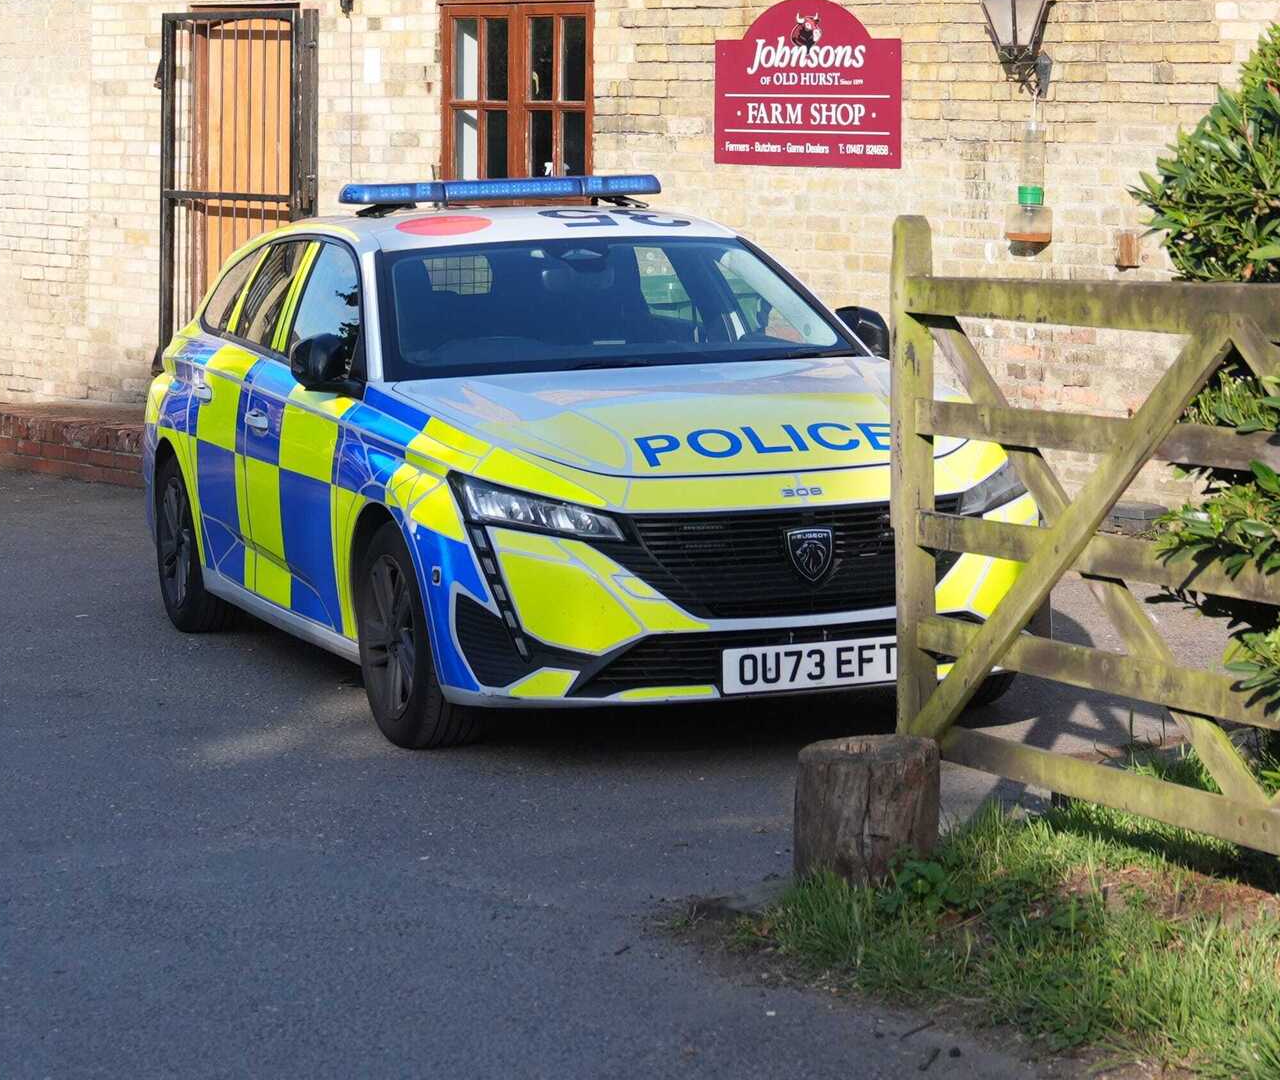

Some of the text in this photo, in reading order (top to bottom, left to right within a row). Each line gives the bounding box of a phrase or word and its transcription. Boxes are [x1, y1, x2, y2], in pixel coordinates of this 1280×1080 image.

[746, 36, 866, 75] Johnsons
[760, 76, 771, 85] OF
[773, 72, 798, 86] OLD
[800, 72, 840, 86] HURST
[746, 102, 866, 126] FARM SHOP
[725, 141, 750, 152] Farmers
[754, 141, 782, 153] Butchers
[786, 142, 805, 153] Game
[805, 142, 830, 154] Dealers
[634, 422, 891, 468] POLICE
[782, 487, 823, 497] 308
[790, 532, 829, 540] PEUGEOT
[739, 642, 897, 686] OU73 EFT
